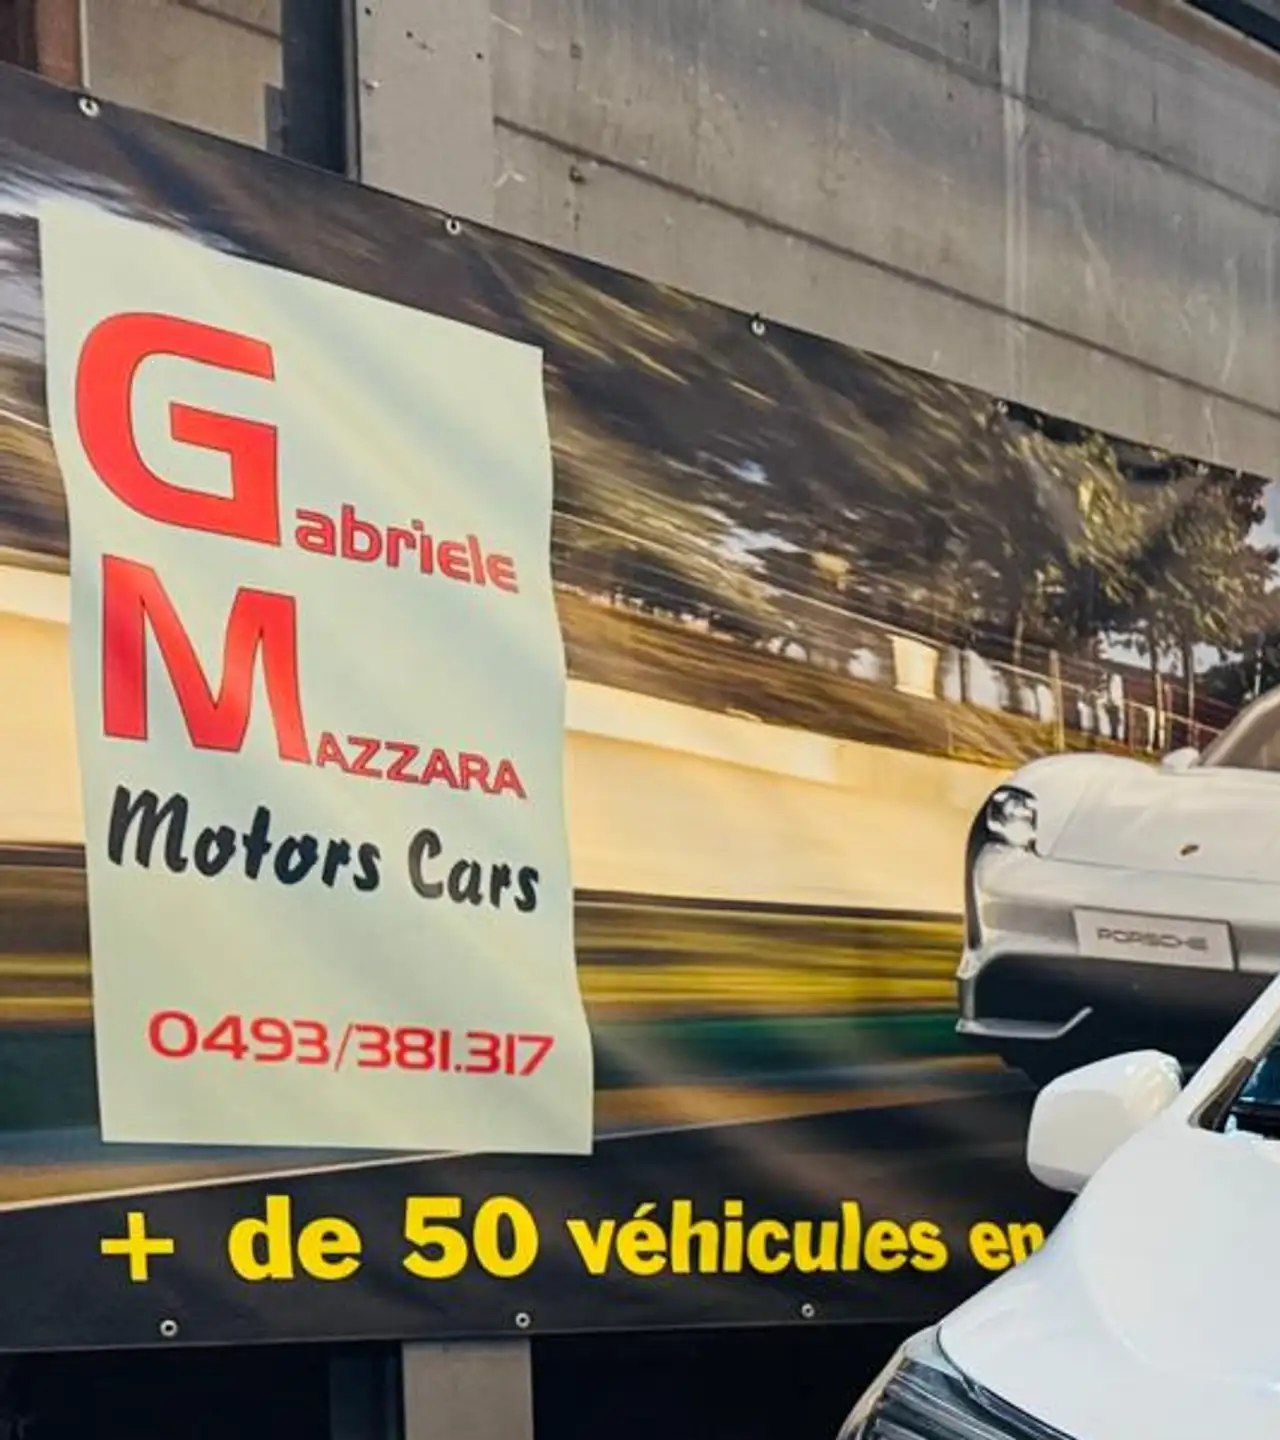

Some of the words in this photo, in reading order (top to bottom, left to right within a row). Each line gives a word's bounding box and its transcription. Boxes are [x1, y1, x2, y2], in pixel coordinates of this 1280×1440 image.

[74, 312, 520, 594] Gabriele
[101, 553, 527, 799] MAZZARA
[107, 785, 381, 892] Motors
[408, 828, 539, 913] Cars
[148, 1010, 554, 1077] 0493/381.317
[228, 1195, 362, 1281] de
[402, 1197, 540, 1278] 50
[566, 1202, 947, 1278] véhicules
[969, 1221, 1046, 1271] en
